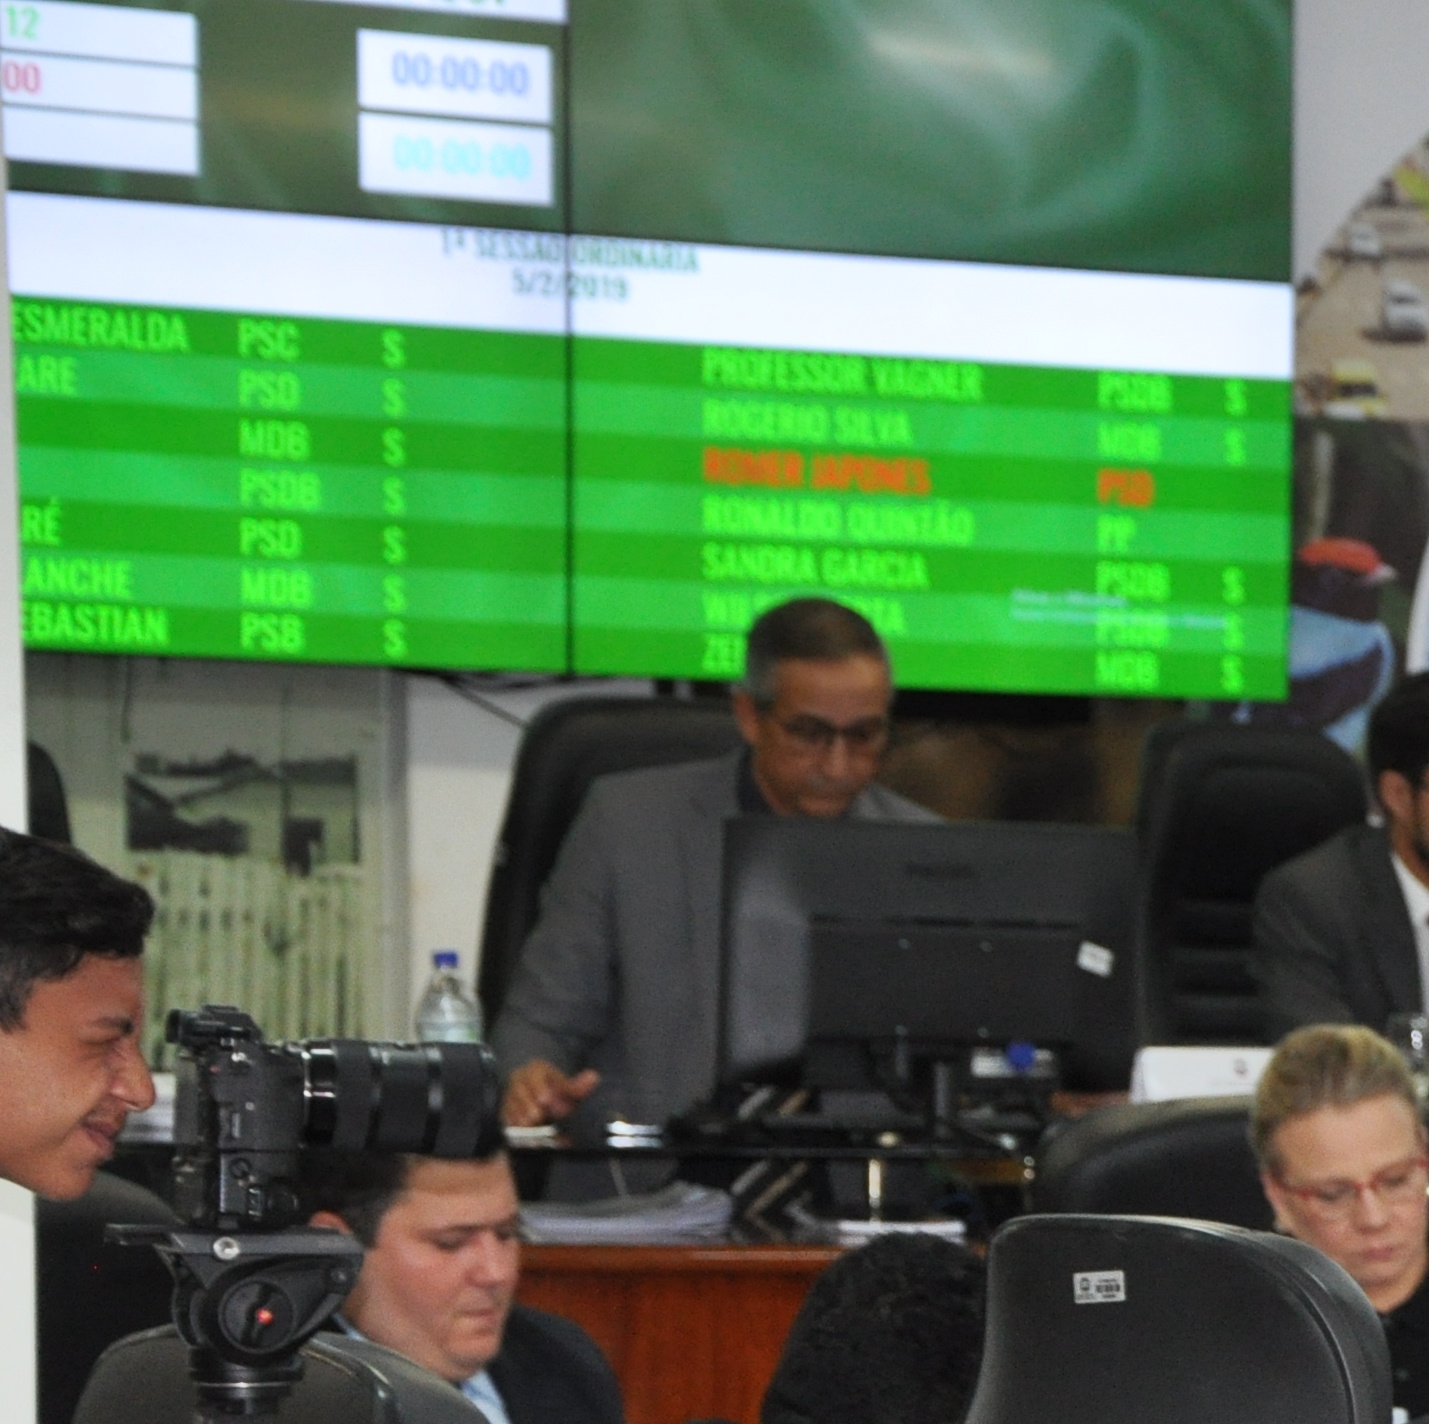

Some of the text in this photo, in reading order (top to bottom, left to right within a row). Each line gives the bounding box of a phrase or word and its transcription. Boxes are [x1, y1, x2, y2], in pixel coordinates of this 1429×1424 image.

[393, 52, 528, 96] 00:00:00
[238, 318, 298, 360] PSC
[383, 329, 405, 368] S
[239, 369, 299, 409] PSD
[383, 377, 405, 417] S
[383, 427, 405, 466] S
[383, 475, 405, 515] S
[240, 517, 301, 559] PSD
[384, 524, 405, 564] S
[384, 574, 405, 613] S
[384, 619, 405, 657] S
